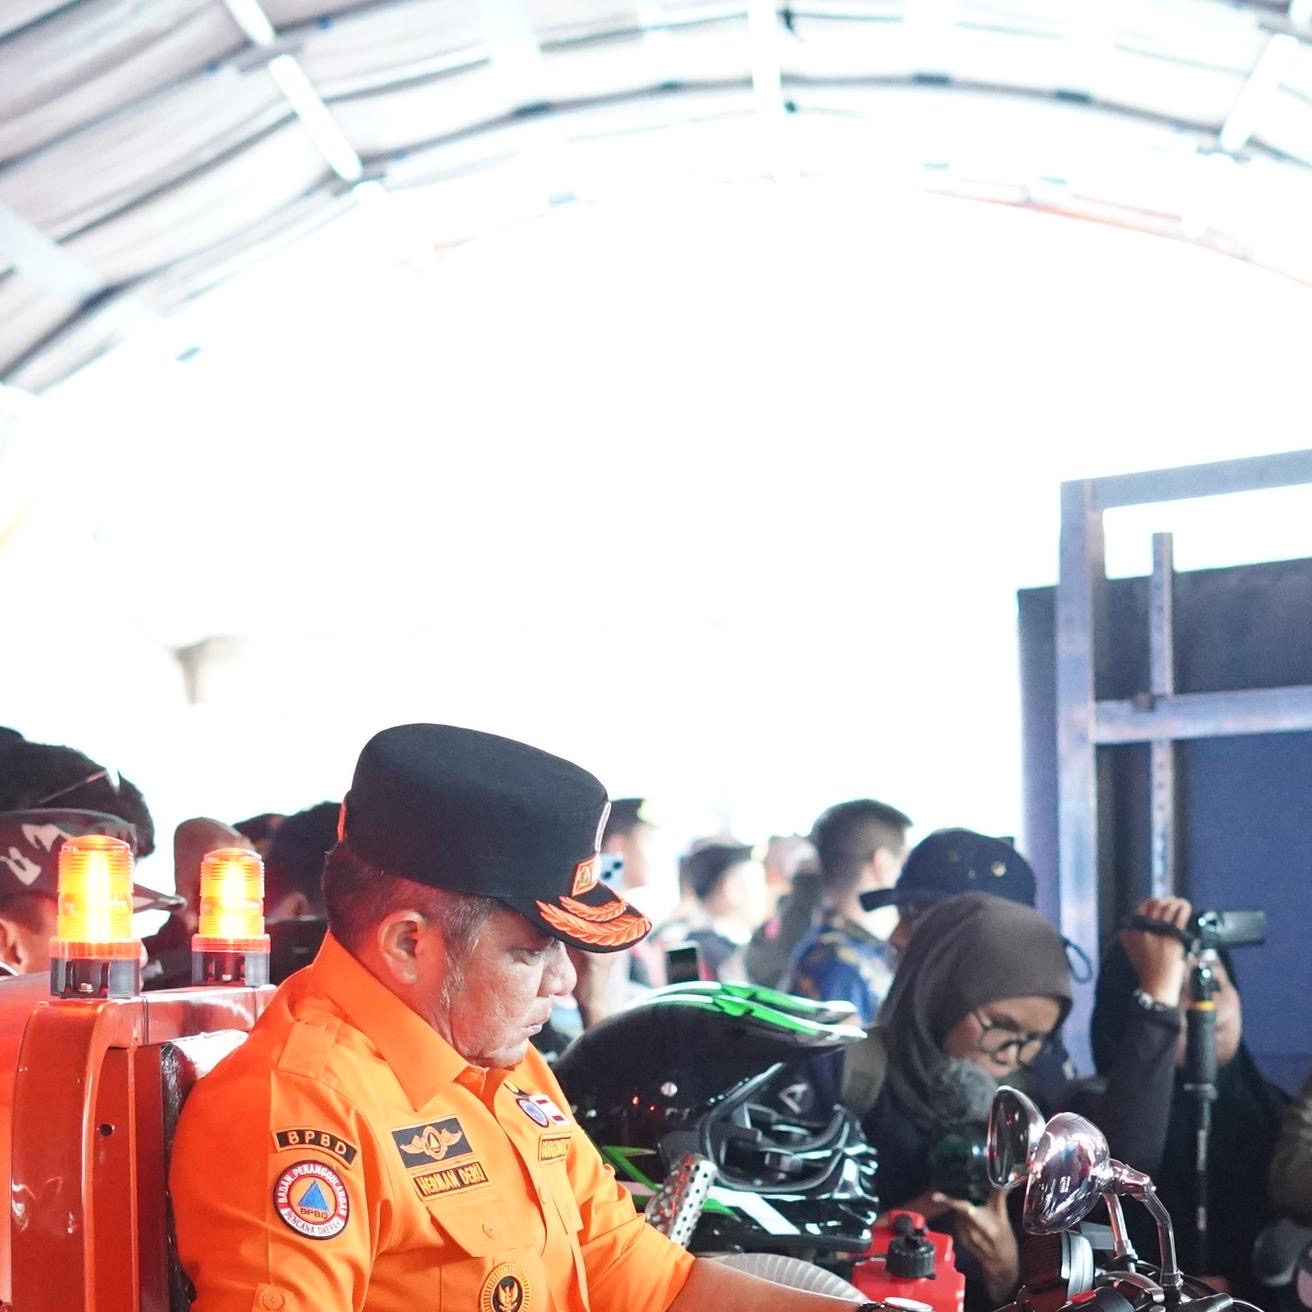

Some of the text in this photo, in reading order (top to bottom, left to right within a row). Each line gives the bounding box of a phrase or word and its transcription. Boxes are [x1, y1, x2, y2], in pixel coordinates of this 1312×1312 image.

[288, 1131, 347, 1154] BPBD
[416, 1162, 487, 1196] HERMAN DERU
